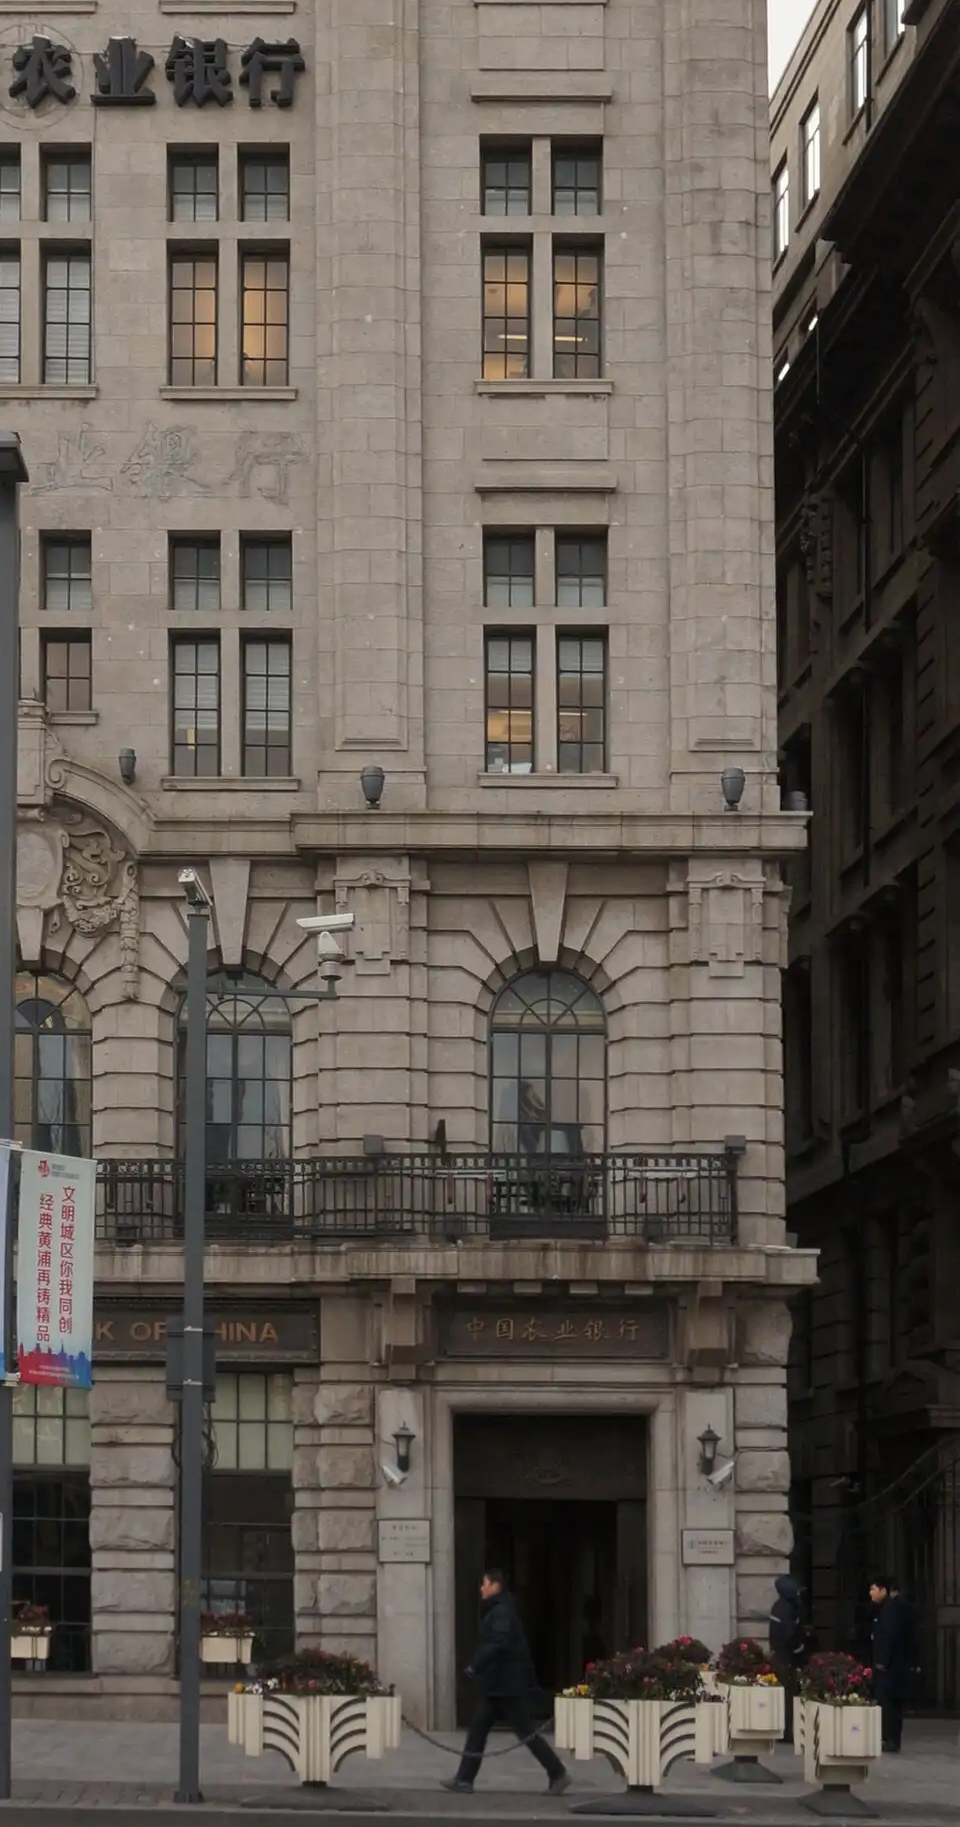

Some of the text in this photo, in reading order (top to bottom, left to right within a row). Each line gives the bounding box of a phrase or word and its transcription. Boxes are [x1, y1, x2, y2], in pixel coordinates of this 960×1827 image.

[36, 1193, 54, 1343] 经典黄浦再铸精品
[58, 1186, 76, 1335] 文明城区你我同创
[466, 1316, 639, 1341] 中国农业银行
